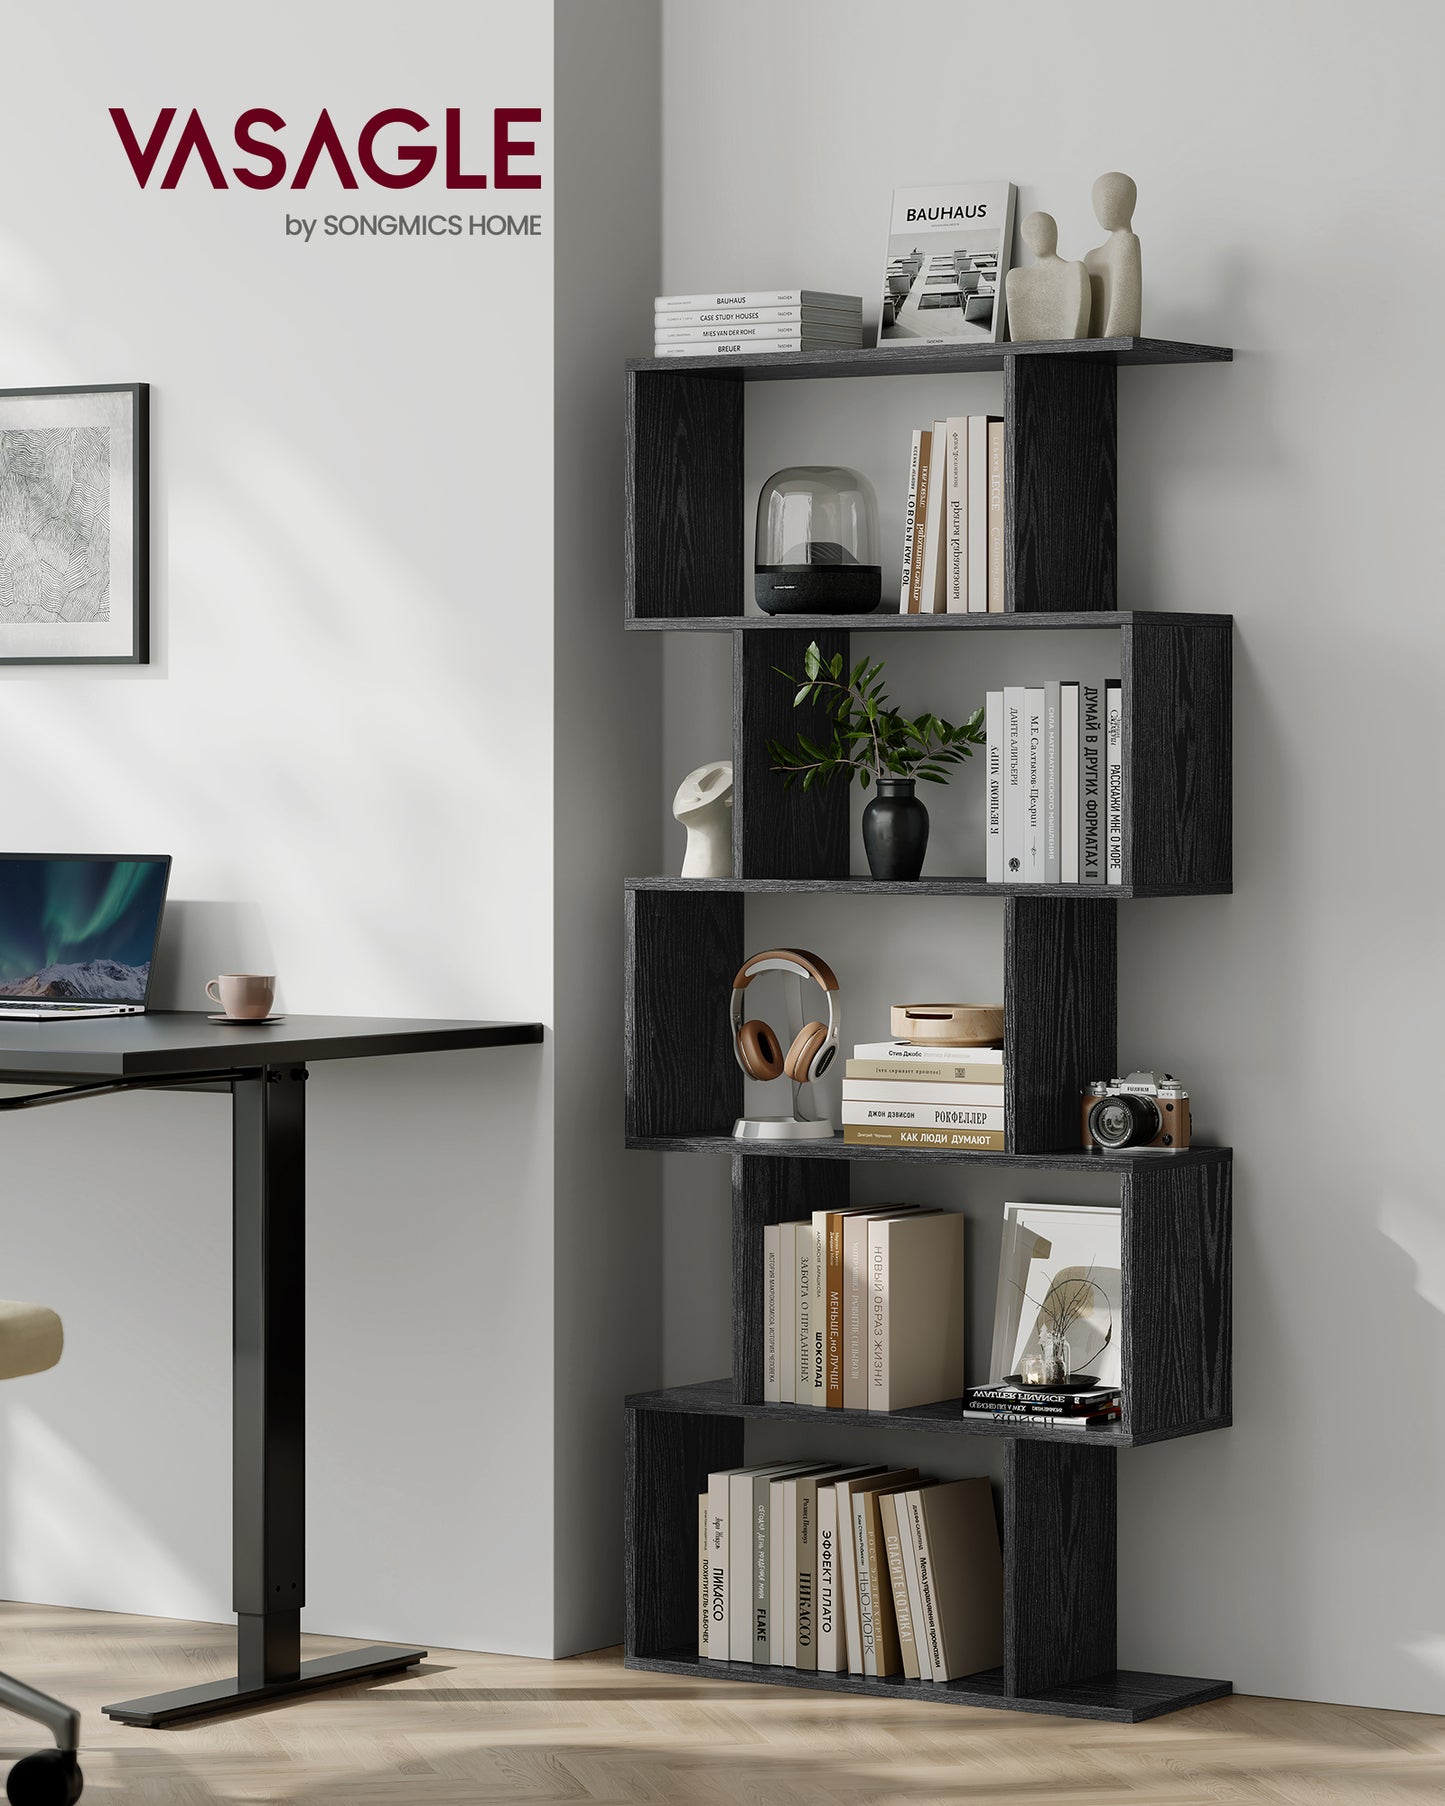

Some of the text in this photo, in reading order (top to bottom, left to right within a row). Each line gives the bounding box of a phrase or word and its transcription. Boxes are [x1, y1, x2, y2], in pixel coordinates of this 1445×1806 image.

[906, 204, 988, 222] BAUHAUS
[700, 314, 715, 322] CASE
[715, 313, 734, 321] STUDY
[735, 312, 759, 320] HOUSES
[716, 296, 746, 305] BAUHAUS
[717, 345, 741, 353] BREUER
[740, 328, 756, 336] ROHE
[1084, 686, 1101, 731] ДУМАЙ
[1009, 707, 1018, 786] ДАНТЕ АЛИГЬЕРИ
[1085, 735, 1098, 743] В
[990, 745, 999, 775] МИРУ
[1084, 747, 1098, 796] ДРУГИХ
[990, 779, 999, 825] ВЕЧНОМУ
[1028, 737, 1039, 828] Салтыков-Щедрин
[1110, 764, 1120, 812] РАССКАЖИ
[1085, 799, 1098, 867] ФОРМАТАХ
[1110, 815, 1120, 834] МНЕ
[1110, 844, 1120, 869] МОРЕ
[903, 1051, 922, 1059] Джобс
[867, 1110, 886, 1118] ДЖОН
[935, 1110, 987, 1125] РОКФЕЛЛЕР
[900, 1132, 918, 1142] КАК
[919, 1133, 948, 1144] ЛЮДИ
[951, 1135, 992, 1146] ДУМАЮТ
[800, 1256, 809, 1383] ЗАБОТА О ПРЕДАННЫХ
[874, 1246, 884, 1387] НОВЫЙ ОБРАЗ ЖИЗНИ
[814, 1332, 823, 1388] ШОКОЛАД
[830, 1353, 839, 1390] ЛУЧШЕ
[822, 1530, 832, 1633] ЭФФЕКТ ПЛАТО
[887, 1535, 913, 1643] СПАСИТЕ КОТИКА!
[919, 1557, 928, 1581] Метод
[713, 1568, 724, 1622] ПИКАССО
[799, 1572, 812, 1647] ПИКАССО
[859, 1571, 875, 1655] НЬЮ-ЙОРК
[757, 1608, 767, 1642] FLAKE
